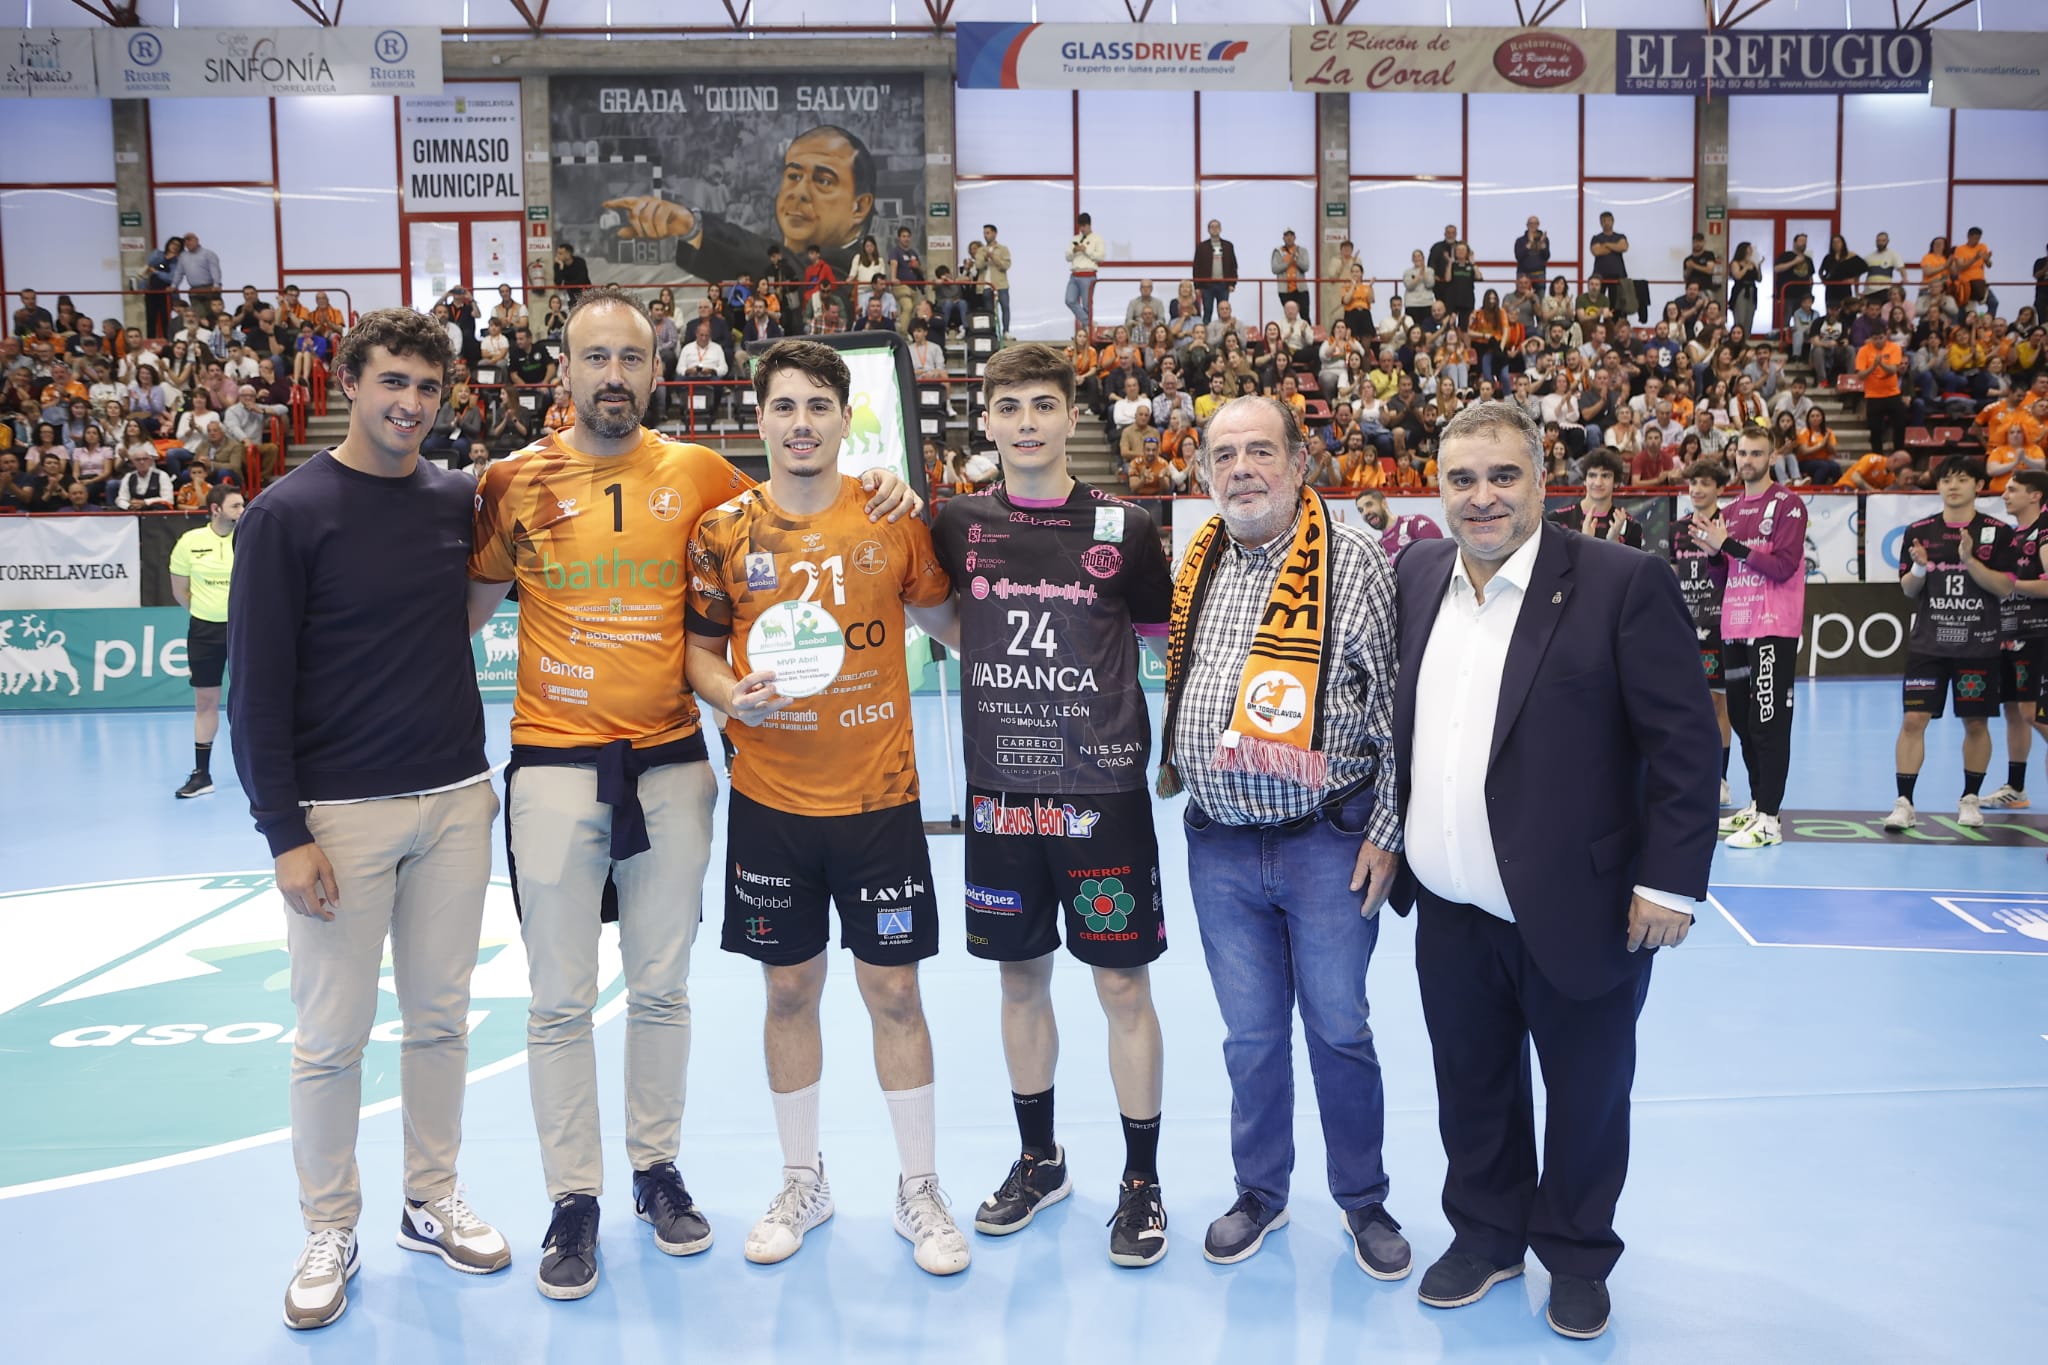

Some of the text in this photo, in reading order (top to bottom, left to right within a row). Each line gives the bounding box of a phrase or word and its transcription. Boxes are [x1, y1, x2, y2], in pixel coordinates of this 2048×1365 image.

[1310, 30, 1450, 51] El Rincón de
[205, 39, 334, 83] SINFONÍA
[1062, 42, 1202, 61] GLASSDRIVE
[1627, 34, 1923, 78] EL REFUGIO
[124, 69, 171, 82] RIGER
[370, 67, 415, 80] RIGER
[1063, 64, 1074, 73] Tu
[1077, 64, 1112, 74] experto
[1128, 63, 1153, 73] lunas
[1155, 66, 1177, 75] para
[1179, 63, 1187, 73] el
[1189, 64, 1235, 74] automóvil
[1305, 55, 1456, 90] La Coral
[1508, 62, 1572, 78] La Coral
[1636, 80, 1654, 88] 942
[1686, 80, 1697, 88] 01
[600, 88, 687, 113] GRADA
[413, 138, 509, 163] GIMNASIO
[412, 173, 520, 198] MUNICIPAL
[604, 483, 623, 532] 1
[543, 548, 678, 590] bathco
[790, 555, 846, 605] 21
[1944, 574, 1965, 596] 13
[1007, 610, 1058, 657] 24
[540, 656, 594, 680] Bankia
[1757, 644, 1775, 723] Kappa
[839, 701, 895, 728] alsa
[978, 701, 1090, 718] CASTILLA Y LEÓN
[1259, 705, 1302, 719] TORRELAVEGA
[1002, 738, 1057, 749] CARRERO
[1079, 742, 1142, 756] NISSAN
[1002, 754, 1057, 764] & TEZZA
[1096, 757, 1134, 768] CYASA
[1035, 797, 1065, 836] león
[742, 870, 791, 888] ENERTEC
[1068, 866, 1132, 878] VIVEROS
[965, 888, 1015, 906] odríguez
[1080, 932, 1139, 942] CERECEDO
[50, 1010, 490, 1047] asoal
